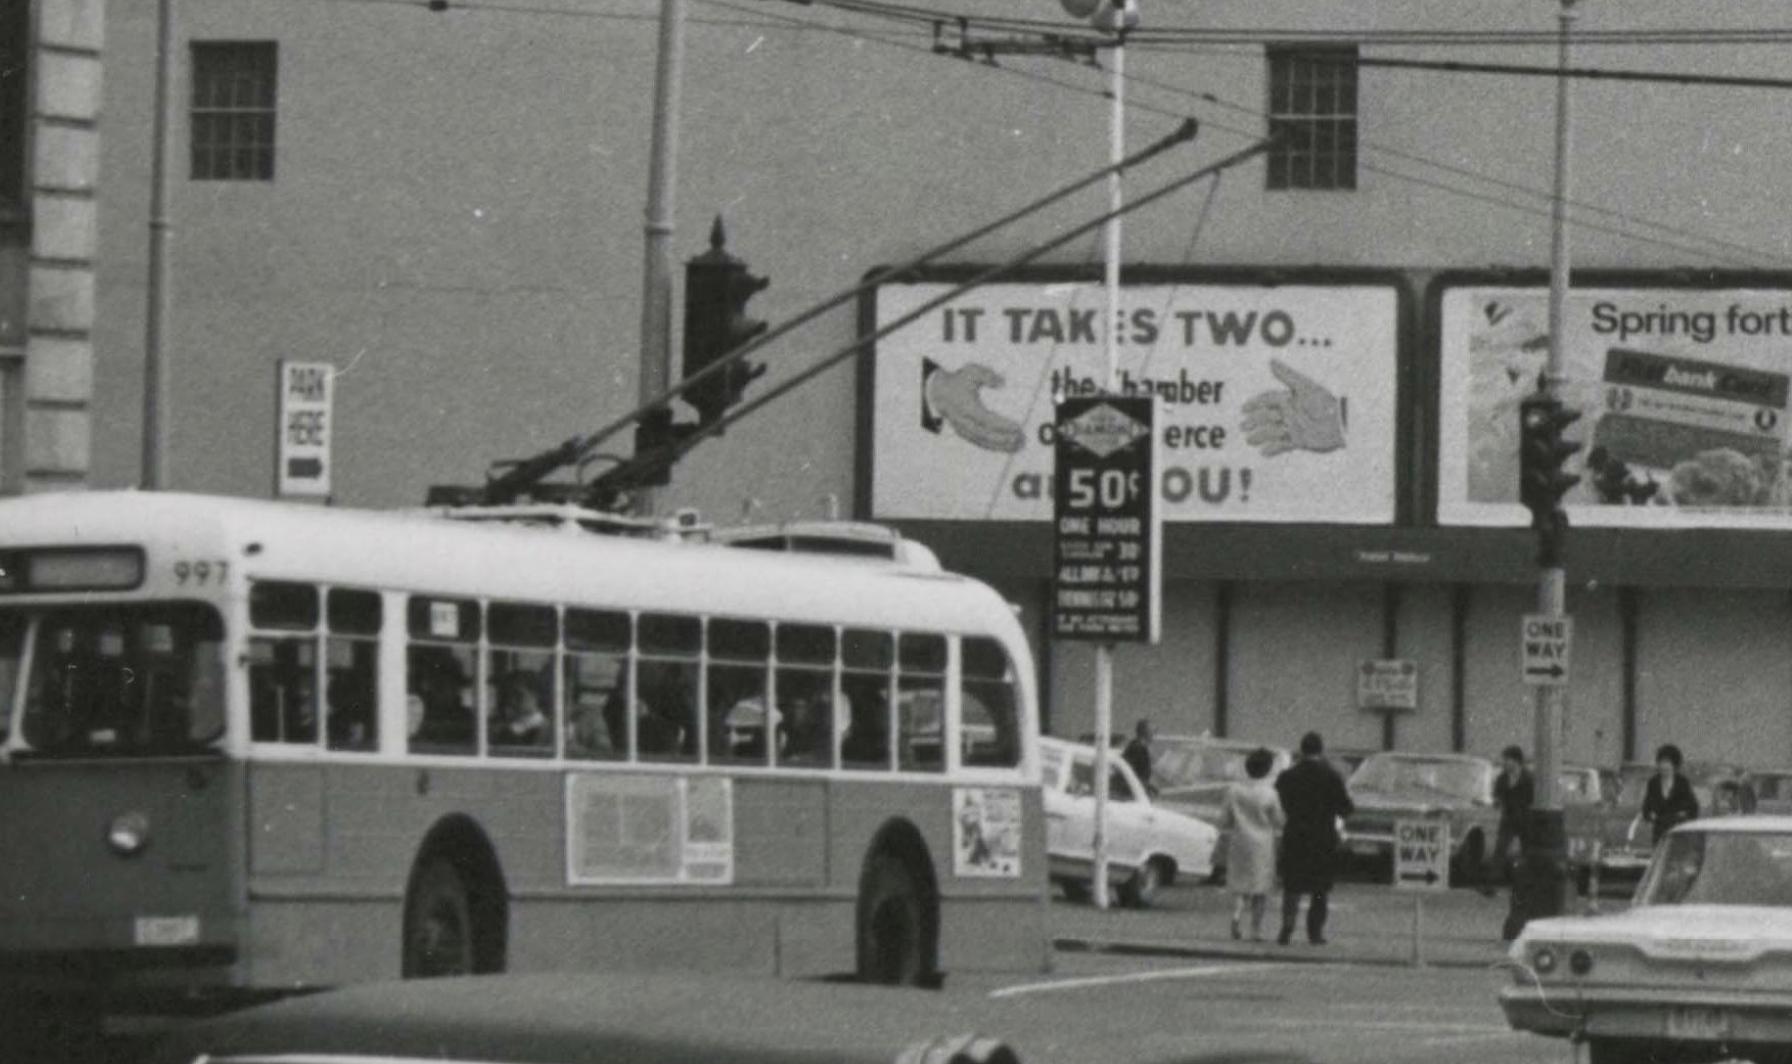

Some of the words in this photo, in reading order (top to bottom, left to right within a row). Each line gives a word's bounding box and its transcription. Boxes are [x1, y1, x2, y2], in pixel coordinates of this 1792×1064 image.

[941, 307, 985, 344] IT
[1175, 308, 1332, 347] TWO...
[1591, 301, 1716, 343] Spring
[289, 367, 325, 402] PARK
[1115, 367, 1224, 404] hamber
[287, 409, 325, 447] HERE
[1160, 466, 1253, 503] OU!
[173, 560, 230, 587] 997
[1527, 621, 1565, 639] ONE
[1525, 641, 1566, 659] WAY
[1401, 822, 1439, 842] ONE
[1400, 845, 1440, 863] WAY
